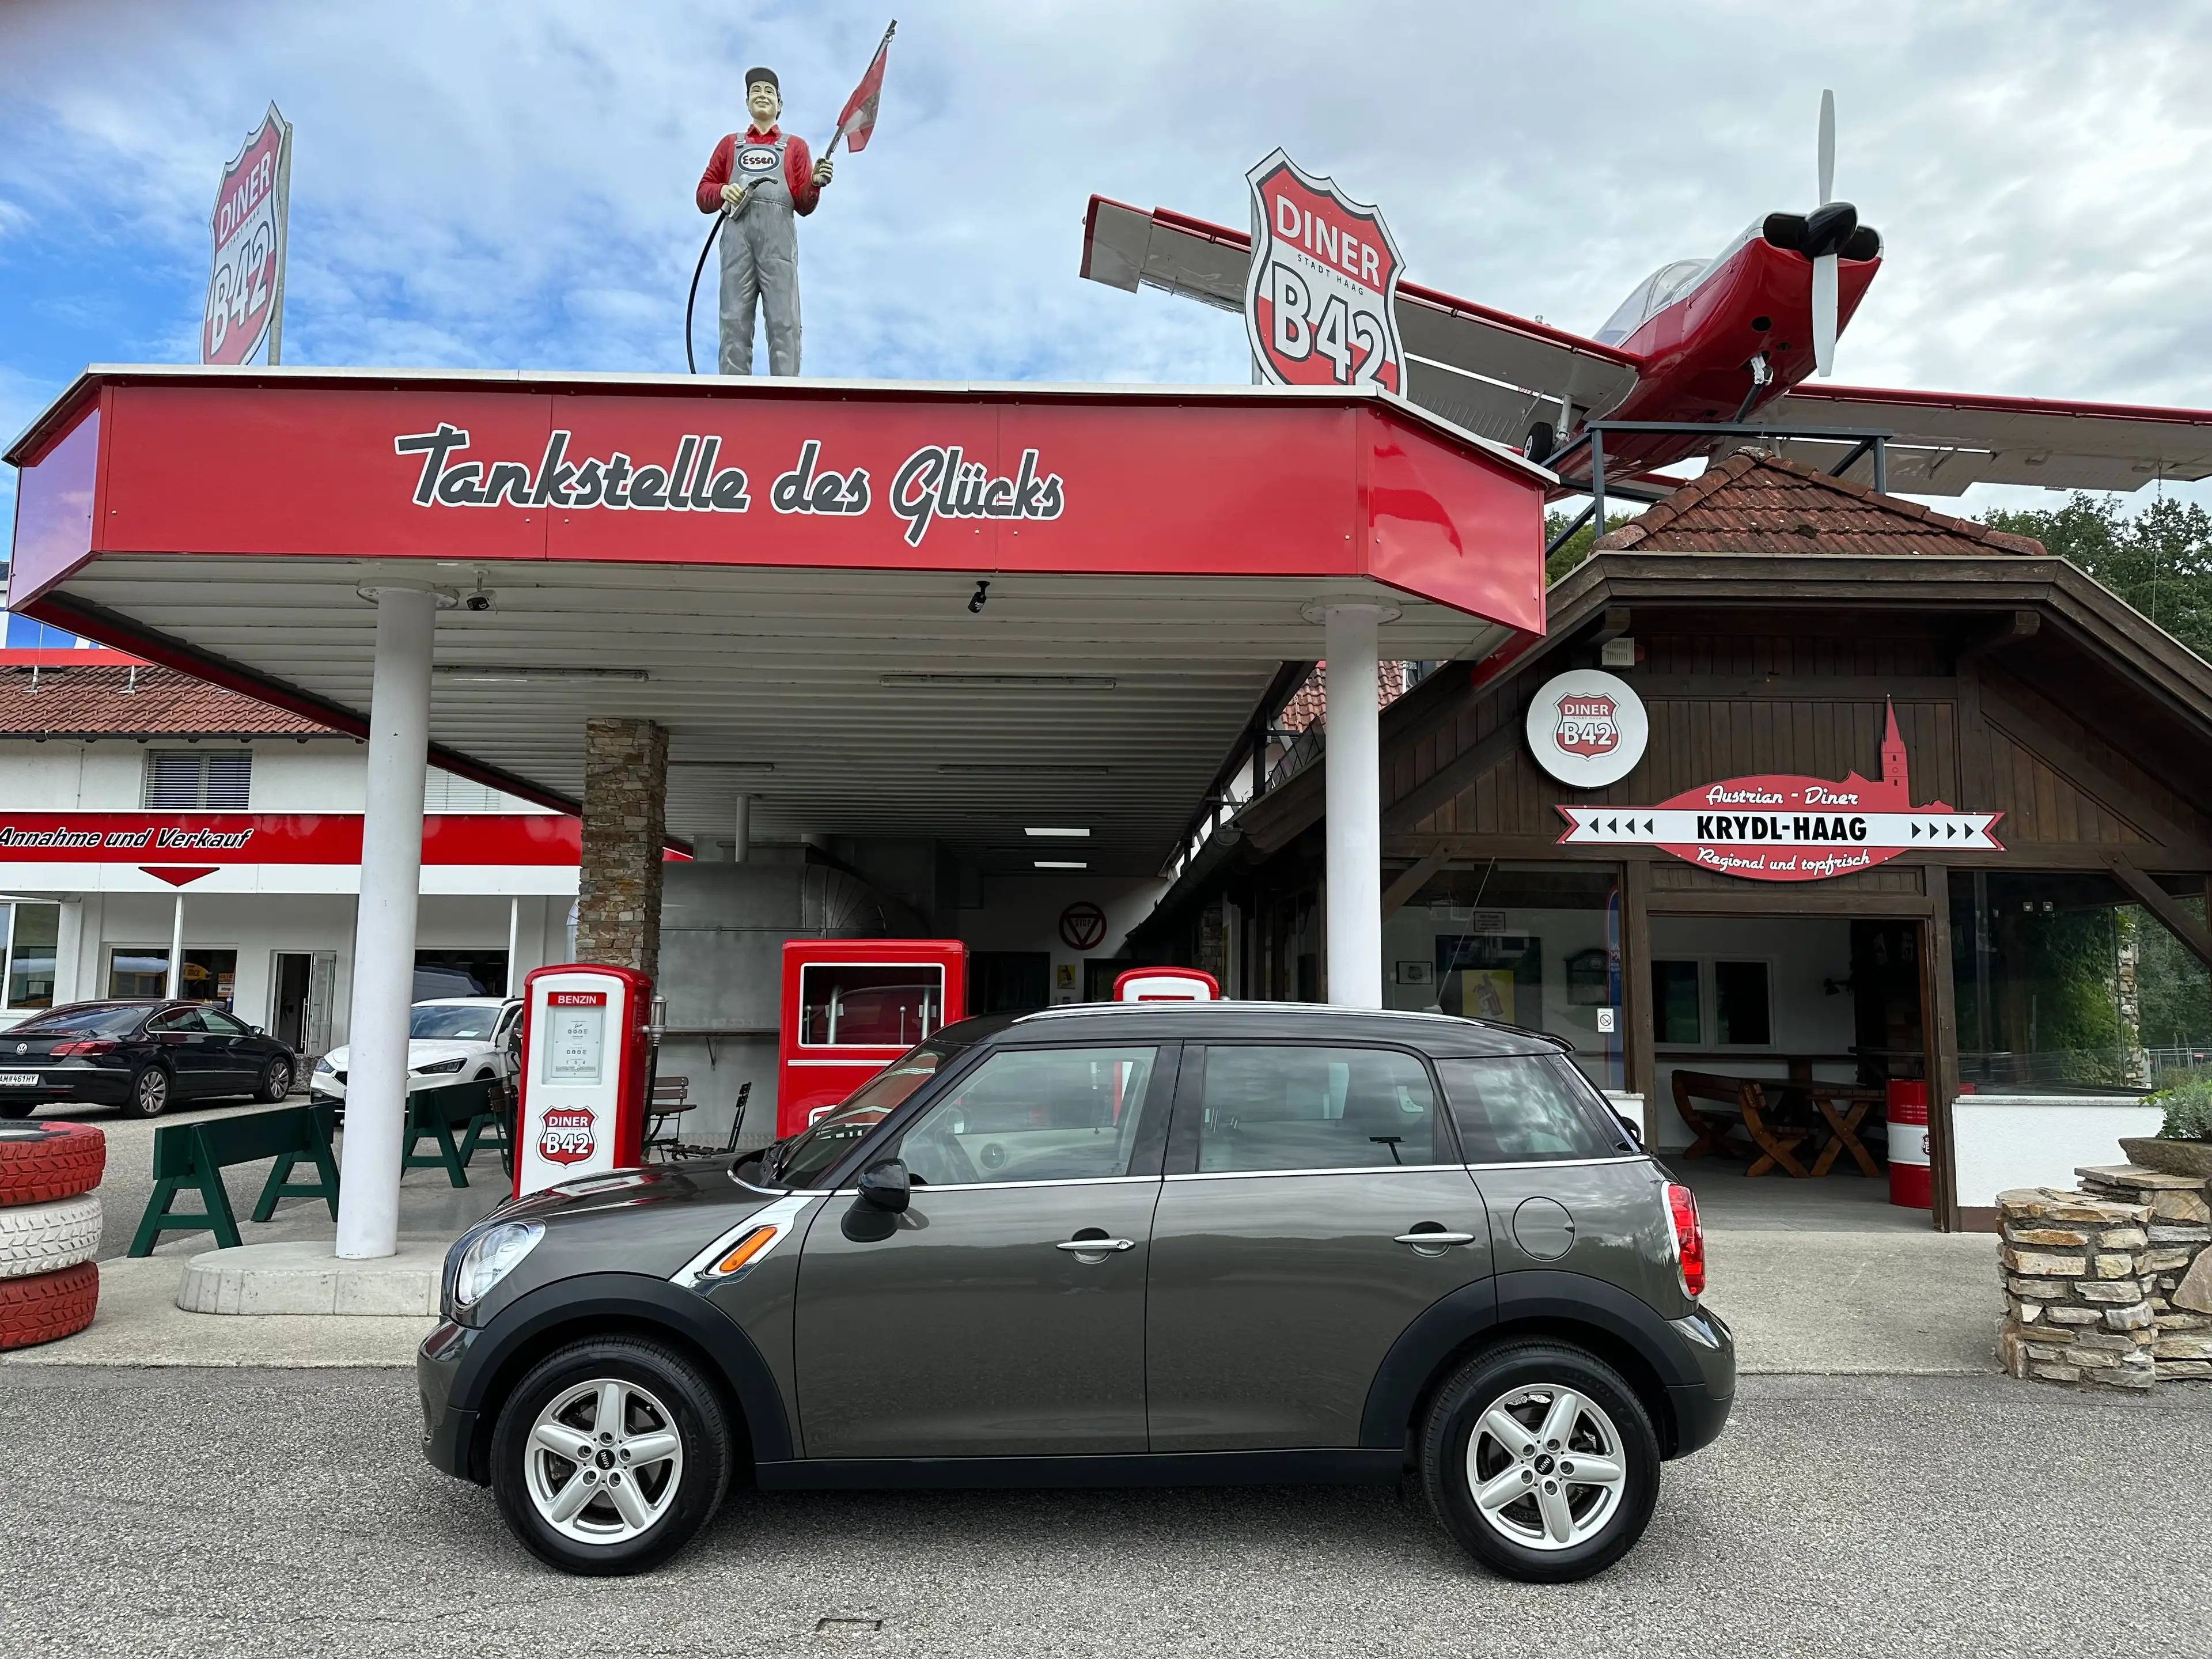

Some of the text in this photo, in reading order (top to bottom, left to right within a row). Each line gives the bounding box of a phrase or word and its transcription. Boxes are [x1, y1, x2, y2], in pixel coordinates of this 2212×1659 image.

[742, 154, 774, 165] Essen
[219, 151, 271, 245] DINER
[226, 207, 260, 251] STADT HAAG
[1277, 194, 1381, 288] DINER
[1297, 253, 1363, 296] STADT HAAG
[209, 220, 271, 359] B42
[1272, 260, 1388, 389] B42
[393, 422, 1065, 548] Tankstelle des Glücks
[1564, 704, 1609, 715] DINER
[1563, 722, 1612, 745] B42
[1706, 785, 1784, 805] Austrian
[1804, 786, 1859, 805] Diner
[0, 827, 255, 849] Annahme und Verkauf
[1697, 816, 1867, 841] KRYDL-HAAG
[1696, 847, 1871, 876] Regional und topfrisch
[1075, 919, 1091, 927] STOP
[558, 995, 597, 1004] BENZIN
[549, 1116, 588, 1126] DINER
[546, 1132, 589, 1154] B42
[600, 1452, 610, 1468] MINI
[1538, 1457, 1551, 1472] MINI
